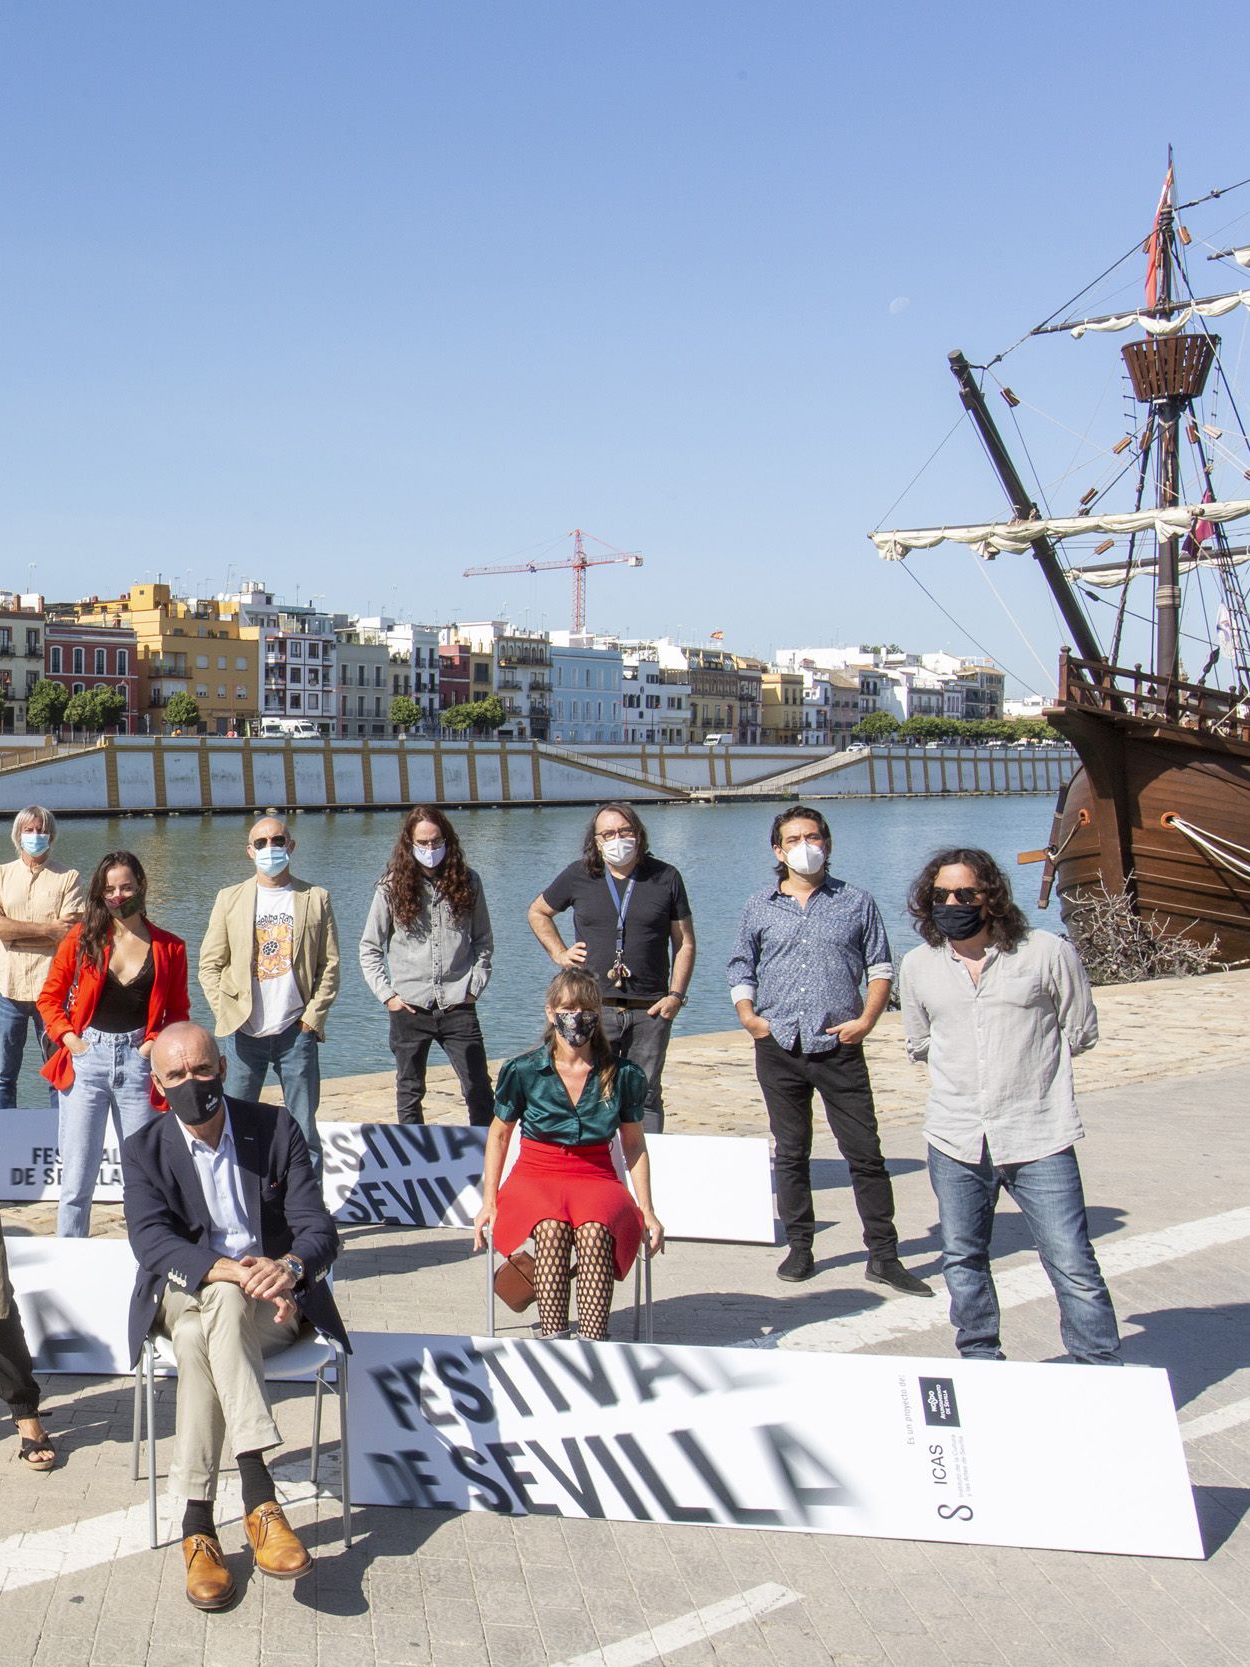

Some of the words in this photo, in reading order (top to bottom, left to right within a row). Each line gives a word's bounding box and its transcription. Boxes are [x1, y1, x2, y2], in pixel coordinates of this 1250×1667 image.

[11, 1167, 36, 1186] DE
[900, 1389, 913, 1422] proyecto
[906, 1424, 913, 1434] un
[907, 1437, 915, 1445] Es
[366, 1449, 464, 1510] DE
[451, 1422, 859, 1526] SEVILLA
[929, 1444, 947, 1485] ICAS
